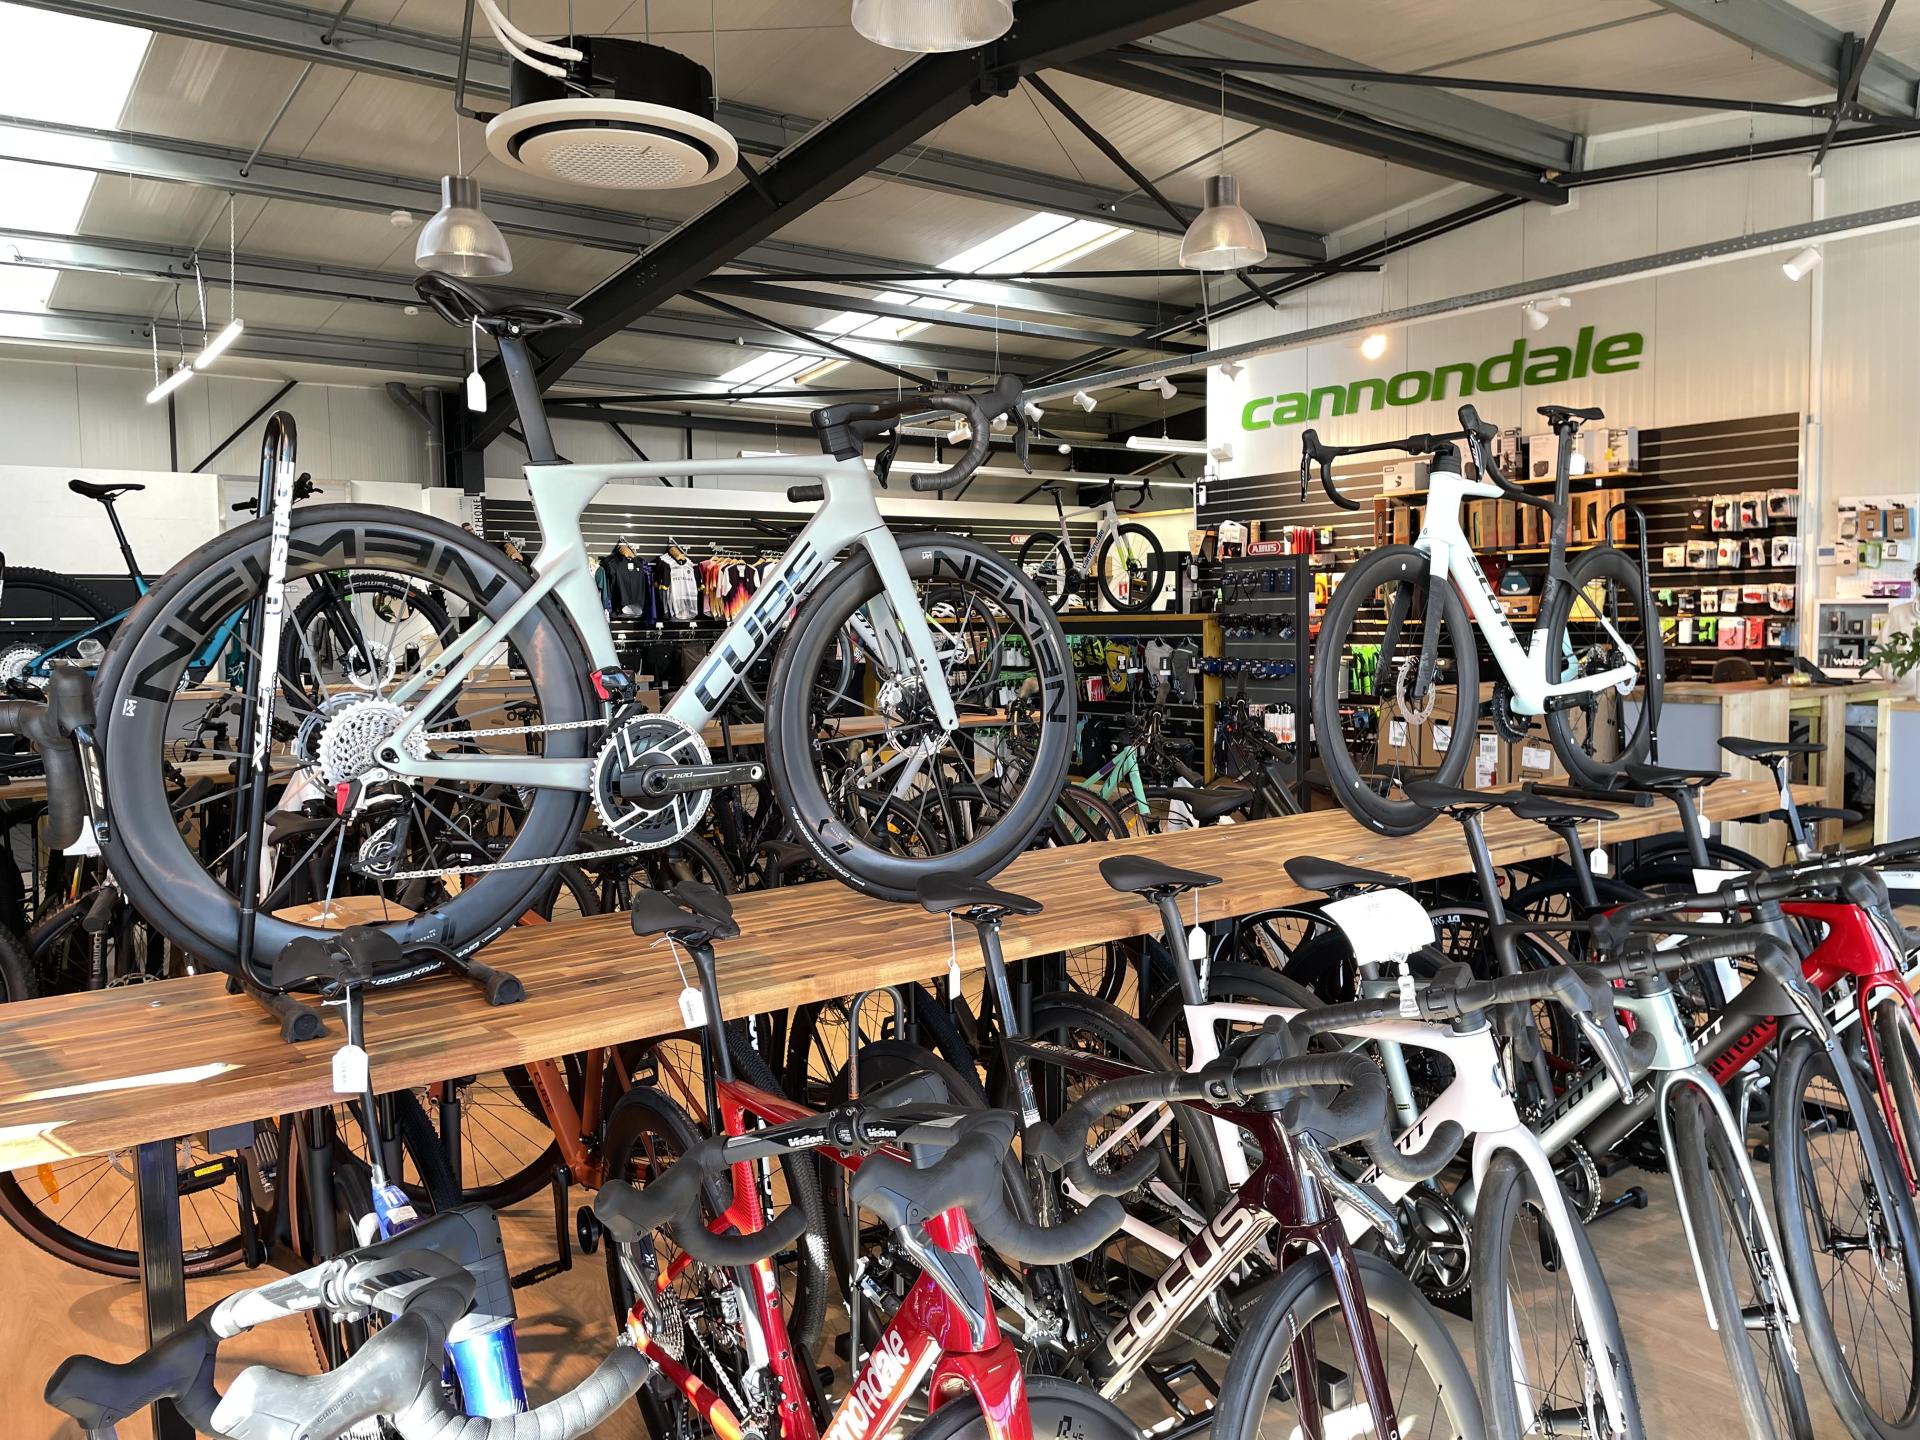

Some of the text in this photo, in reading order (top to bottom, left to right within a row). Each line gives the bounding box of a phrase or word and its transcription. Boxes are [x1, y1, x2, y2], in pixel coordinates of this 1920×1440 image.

[1241, 325, 1644, 432] cannondale
[1083, 529, 1104, 569] cannondale
[1251, 544, 1277, 554] ABUS
[1467, 556, 1518, 644] SCOTT
[694, 541, 823, 712] CUBE
[534, 1071, 554, 1114] CUBE
[1540, 1069, 1608, 1134] SCOTT
[787, 1134, 825, 1148] Vision
[867, 1127, 897, 1138] Vision
[1106, 1193, 1253, 1367] FOCUS
[317, 1391, 355, 1424] SHIMANO
